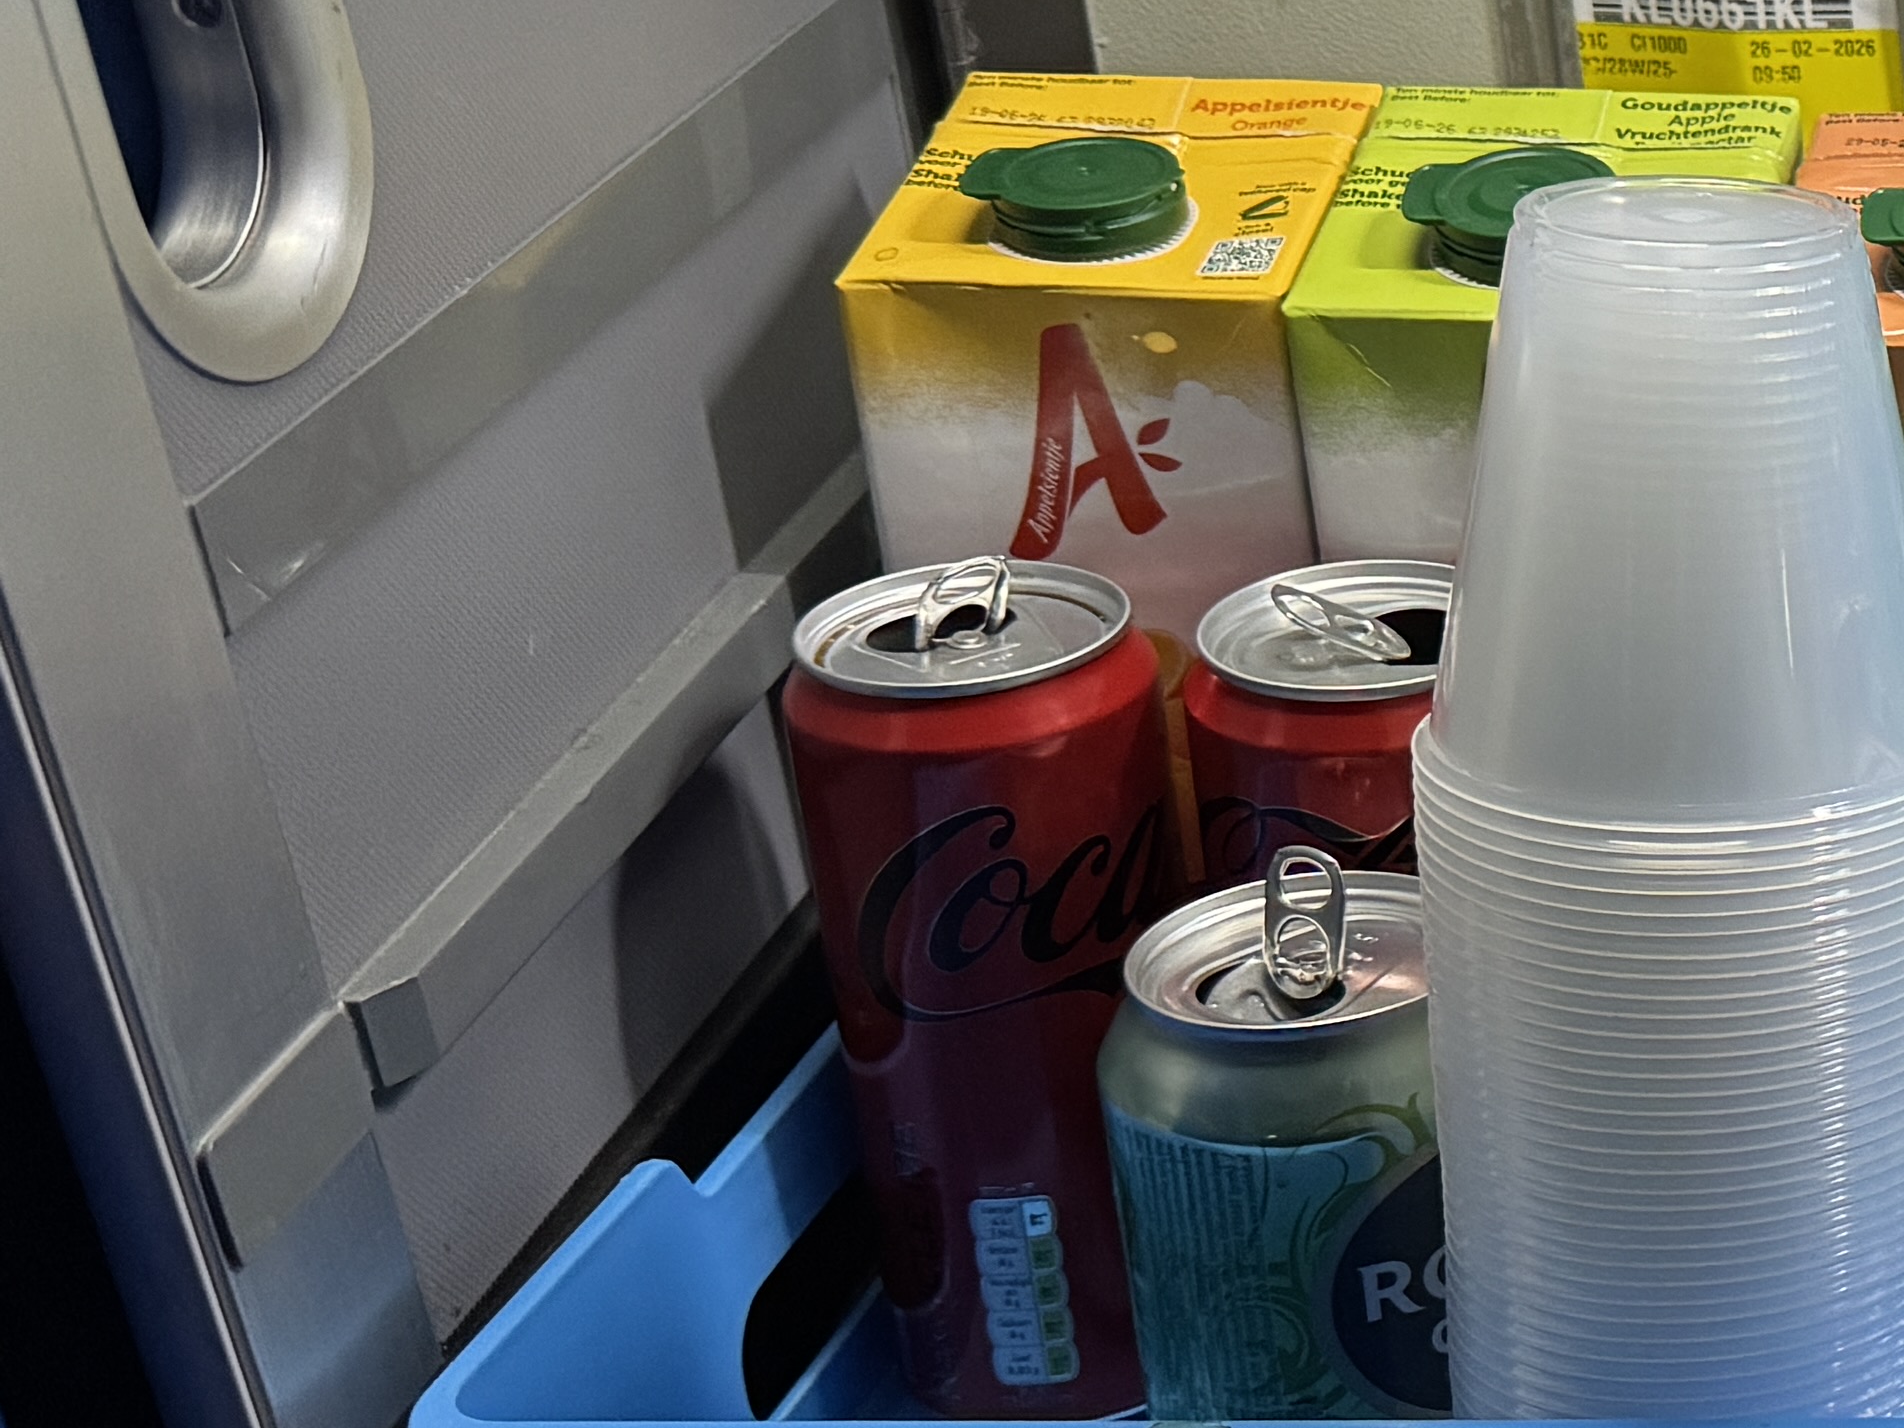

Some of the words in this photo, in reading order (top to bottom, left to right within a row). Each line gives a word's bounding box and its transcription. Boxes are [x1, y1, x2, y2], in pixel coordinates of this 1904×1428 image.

[1190, 97, 1371, 116] Appelsientje
[1620, 97, 1793, 115] Goudappeltje
[1230, 115, 1308, 132] Orange
[1668, 112, 1737, 131] Apple
[1615, 124, 1784, 142] Vruchtendrank
[1027, 436, 1063, 543] Appelsientje
